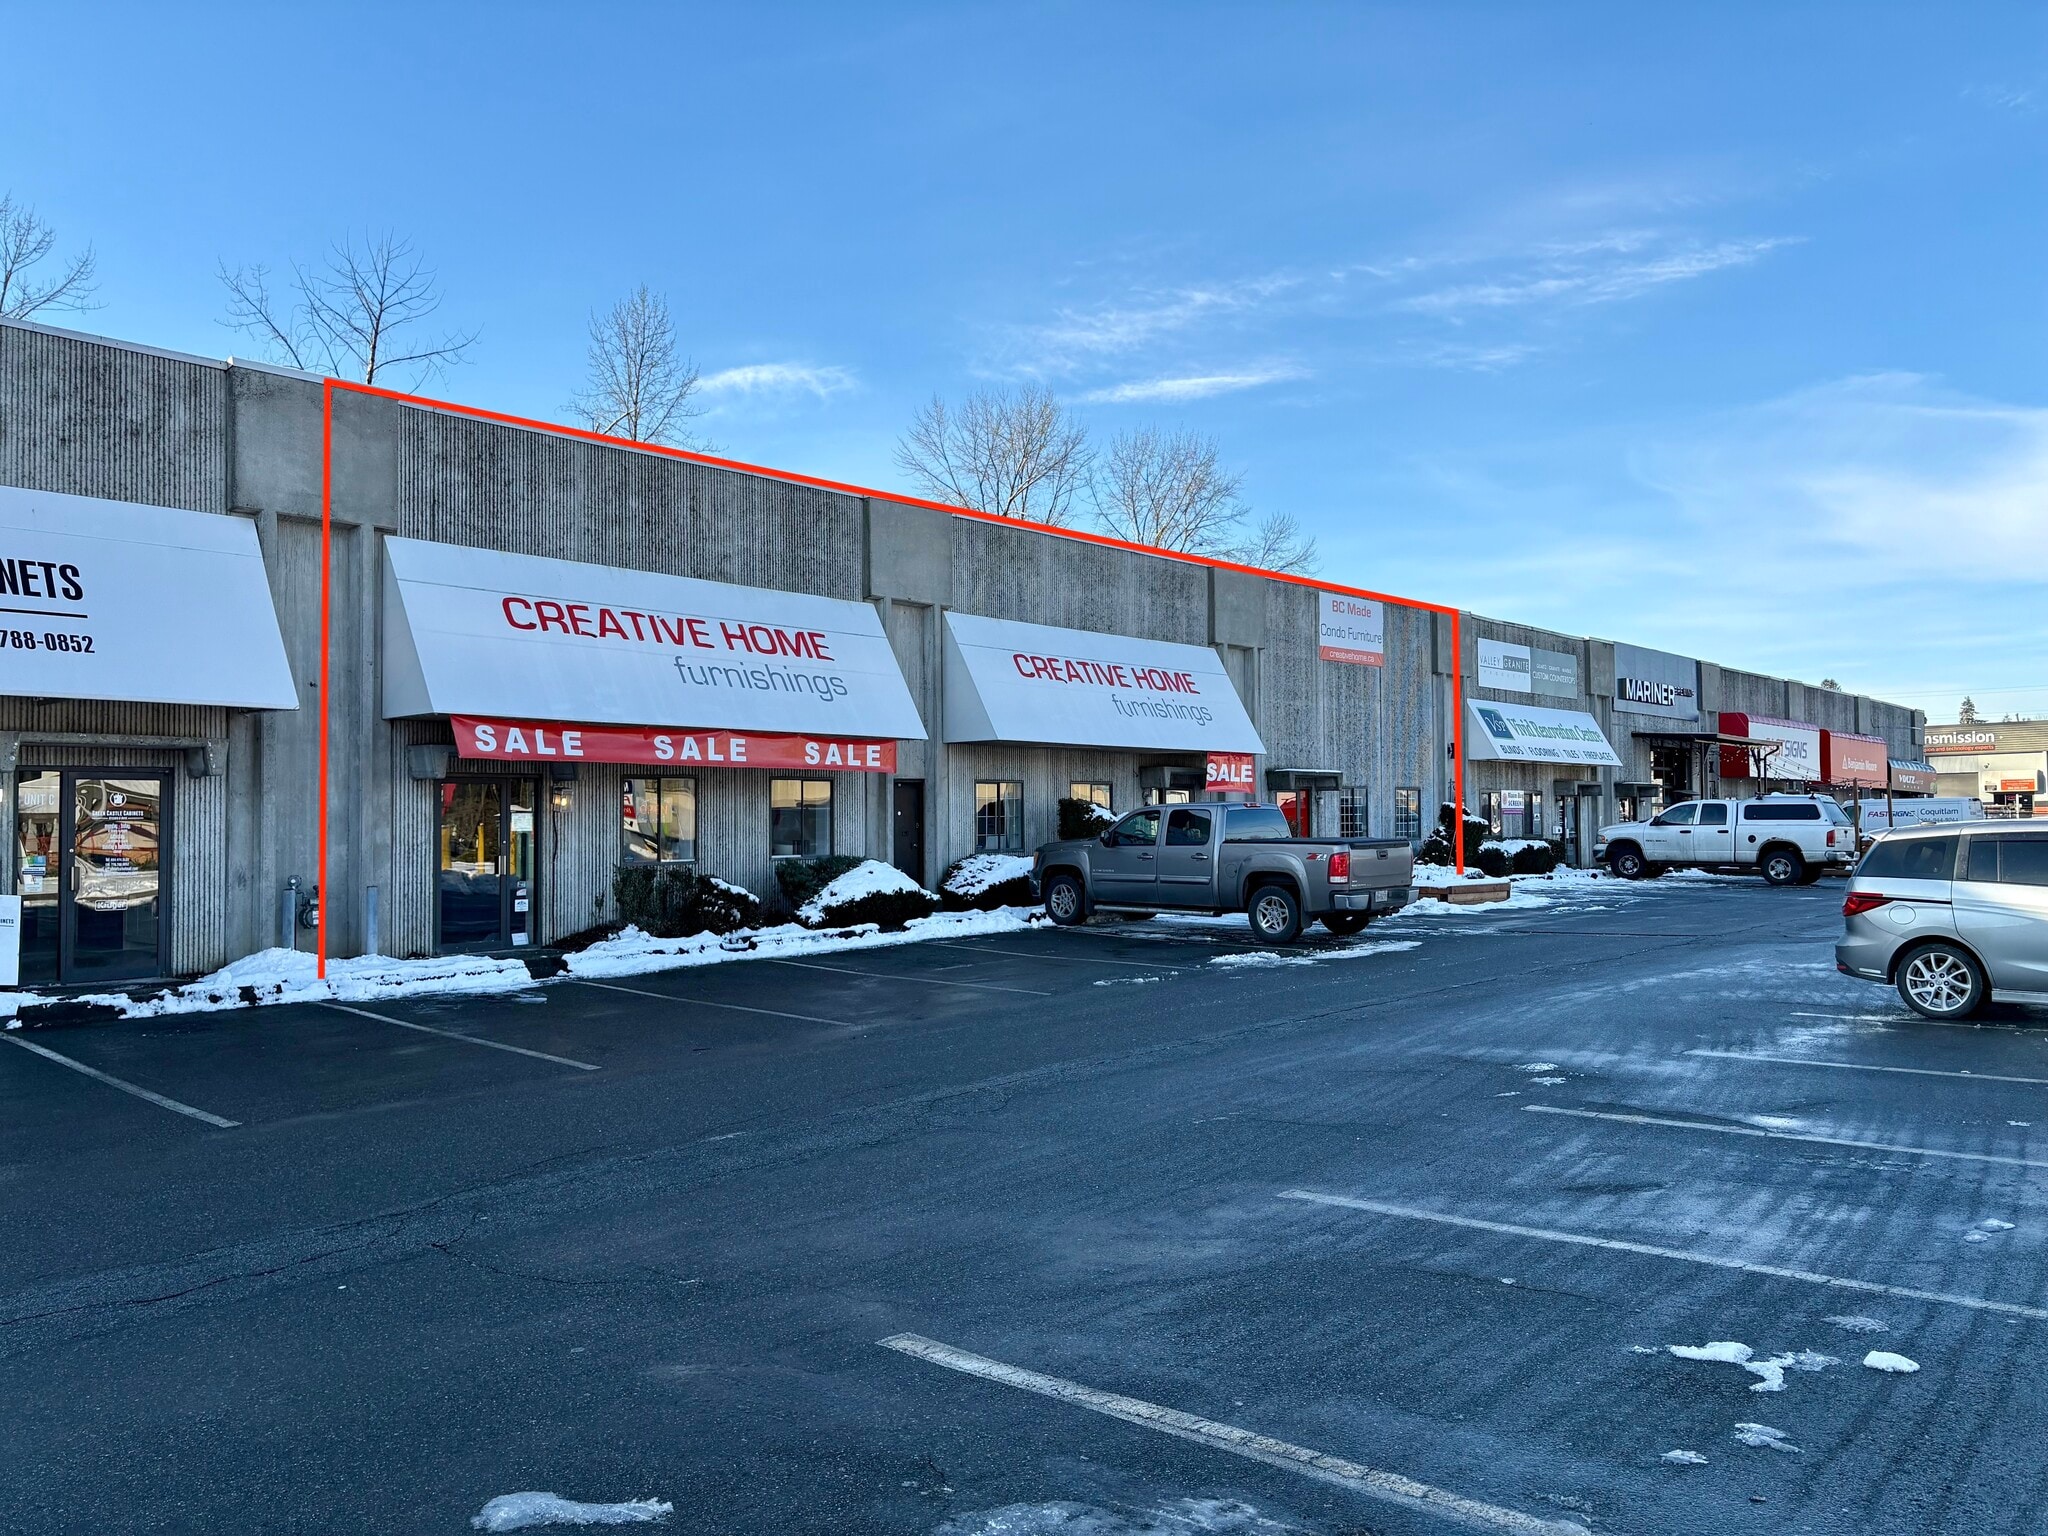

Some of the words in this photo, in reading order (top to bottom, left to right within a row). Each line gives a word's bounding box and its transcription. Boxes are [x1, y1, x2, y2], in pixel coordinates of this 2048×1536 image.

[0, 558, 84, 601] NETS
[1332, 600, 1345, 614] BC
[1347, 602, 1372, 618] Made
[501, 596, 715, 649] CREATIVE
[719, 622, 835, 661] HOME
[1320, 623, 1346, 639] Condo
[1347, 627, 1382, 644] Furniture
[0, 629, 96, 654] 788-0852
[1329, 650, 1375, 663] creativehome.ca
[1479, 655, 1501, 667] VALLEY
[1503, 658, 1529, 671] GRANITE
[674, 655, 849, 702] furnishings
[1013, 653, 1130, 689] CREATIVE
[1131, 668, 1201, 695] HOME
[1626, 678, 1676, 706] MARINER
[1112, 694, 1213, 726] furnishings
[474, 724, 585, 757] SALE
[654, 735, 748, 763] SALE
[804, 742, 882, 767] SALE
[1500, 744, 1525, 756] BLINDS
[1528, 746, 1561, 759] FLOORING
[1562, 749, 1580, 760] TILES
[1206, 761, 1254, 784] SALE
[23, 793, 46, 806] UNIT
[48, 793, 55, 806] C
[1919, 807, 1960, 817] Coquitlam
